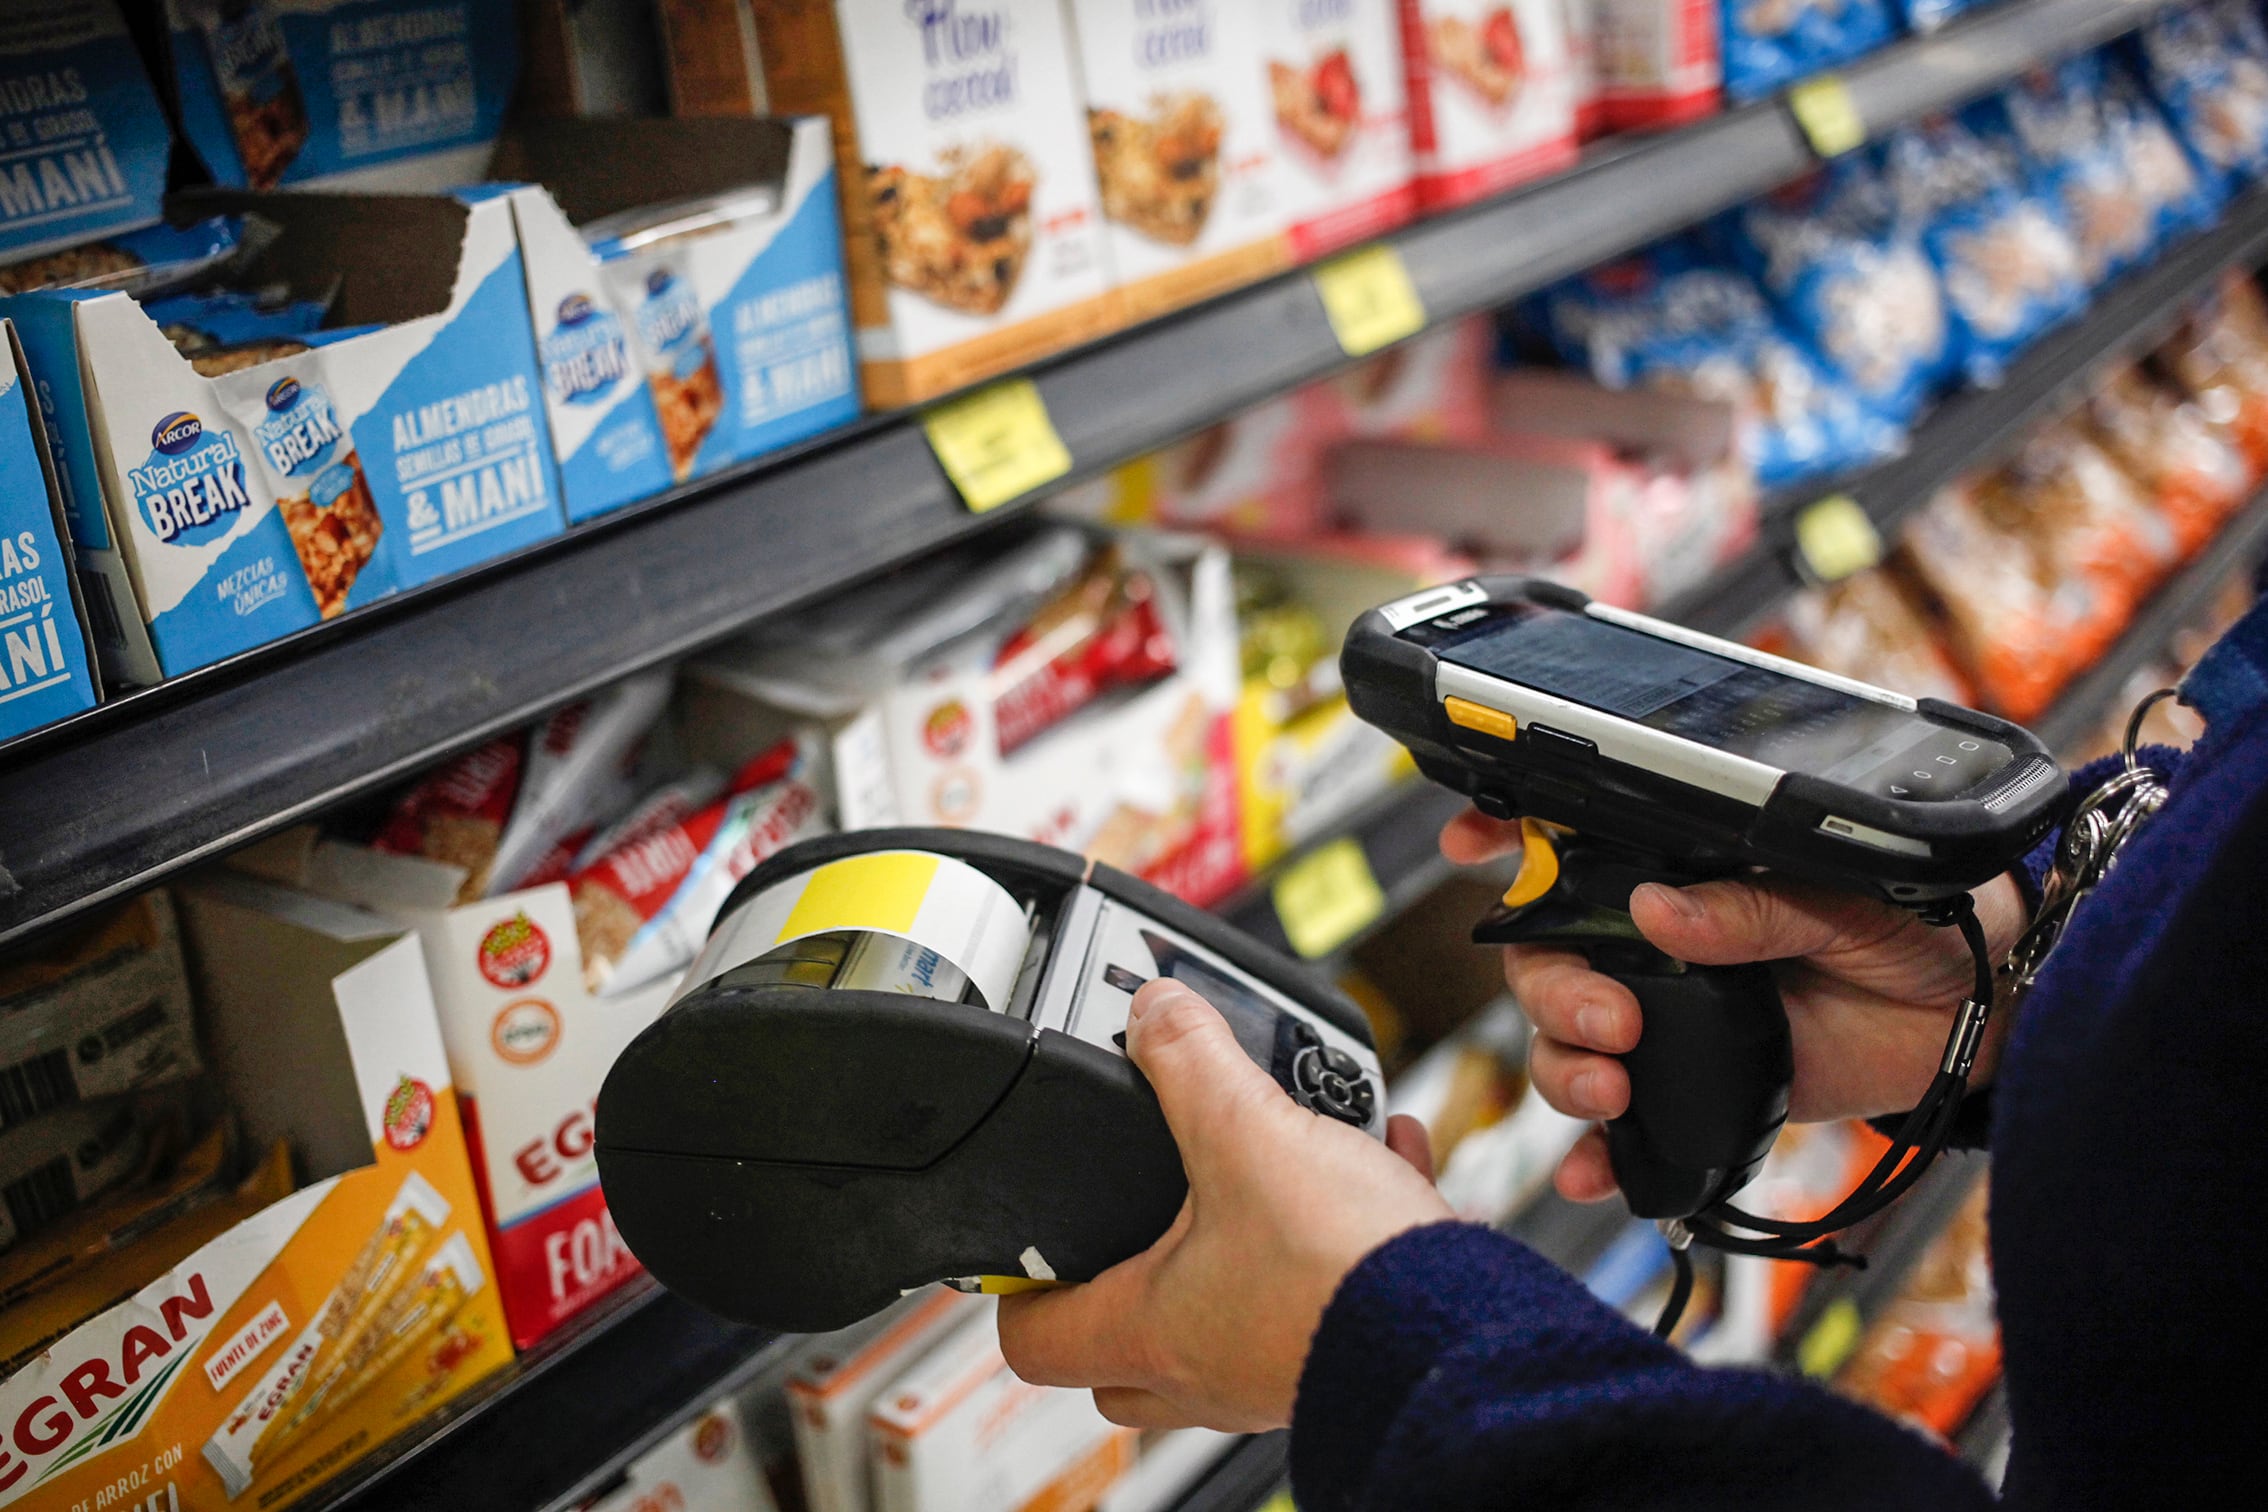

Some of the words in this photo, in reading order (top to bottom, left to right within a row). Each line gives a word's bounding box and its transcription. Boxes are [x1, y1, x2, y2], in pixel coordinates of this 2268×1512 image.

[155, 421, 201, 449] ARCOR
[268, 407, 342, 477] BREAK
[393, 374, 530, 453] ALMENDRAS
[130, 432, 238, 497] Natural
[146, 461, 250, 540] BREAK
[407, 490, 440, 531] &
[441, 441, 546, 532] MANÍ
[217, 556, 275, 601] MEZCLAS
[514, 1098, 596, 1185] EG
[210, 1344, 247, 1382] FUENTE
[244, 1332, 261, 1350] DE
[258, 1309, 284, 1339] ZINC
[257, 1343, 314, 1421] EGRAN
[96, 1464, 150, 1511] ARROZ
[154, 1442, 183, 1475] CON
